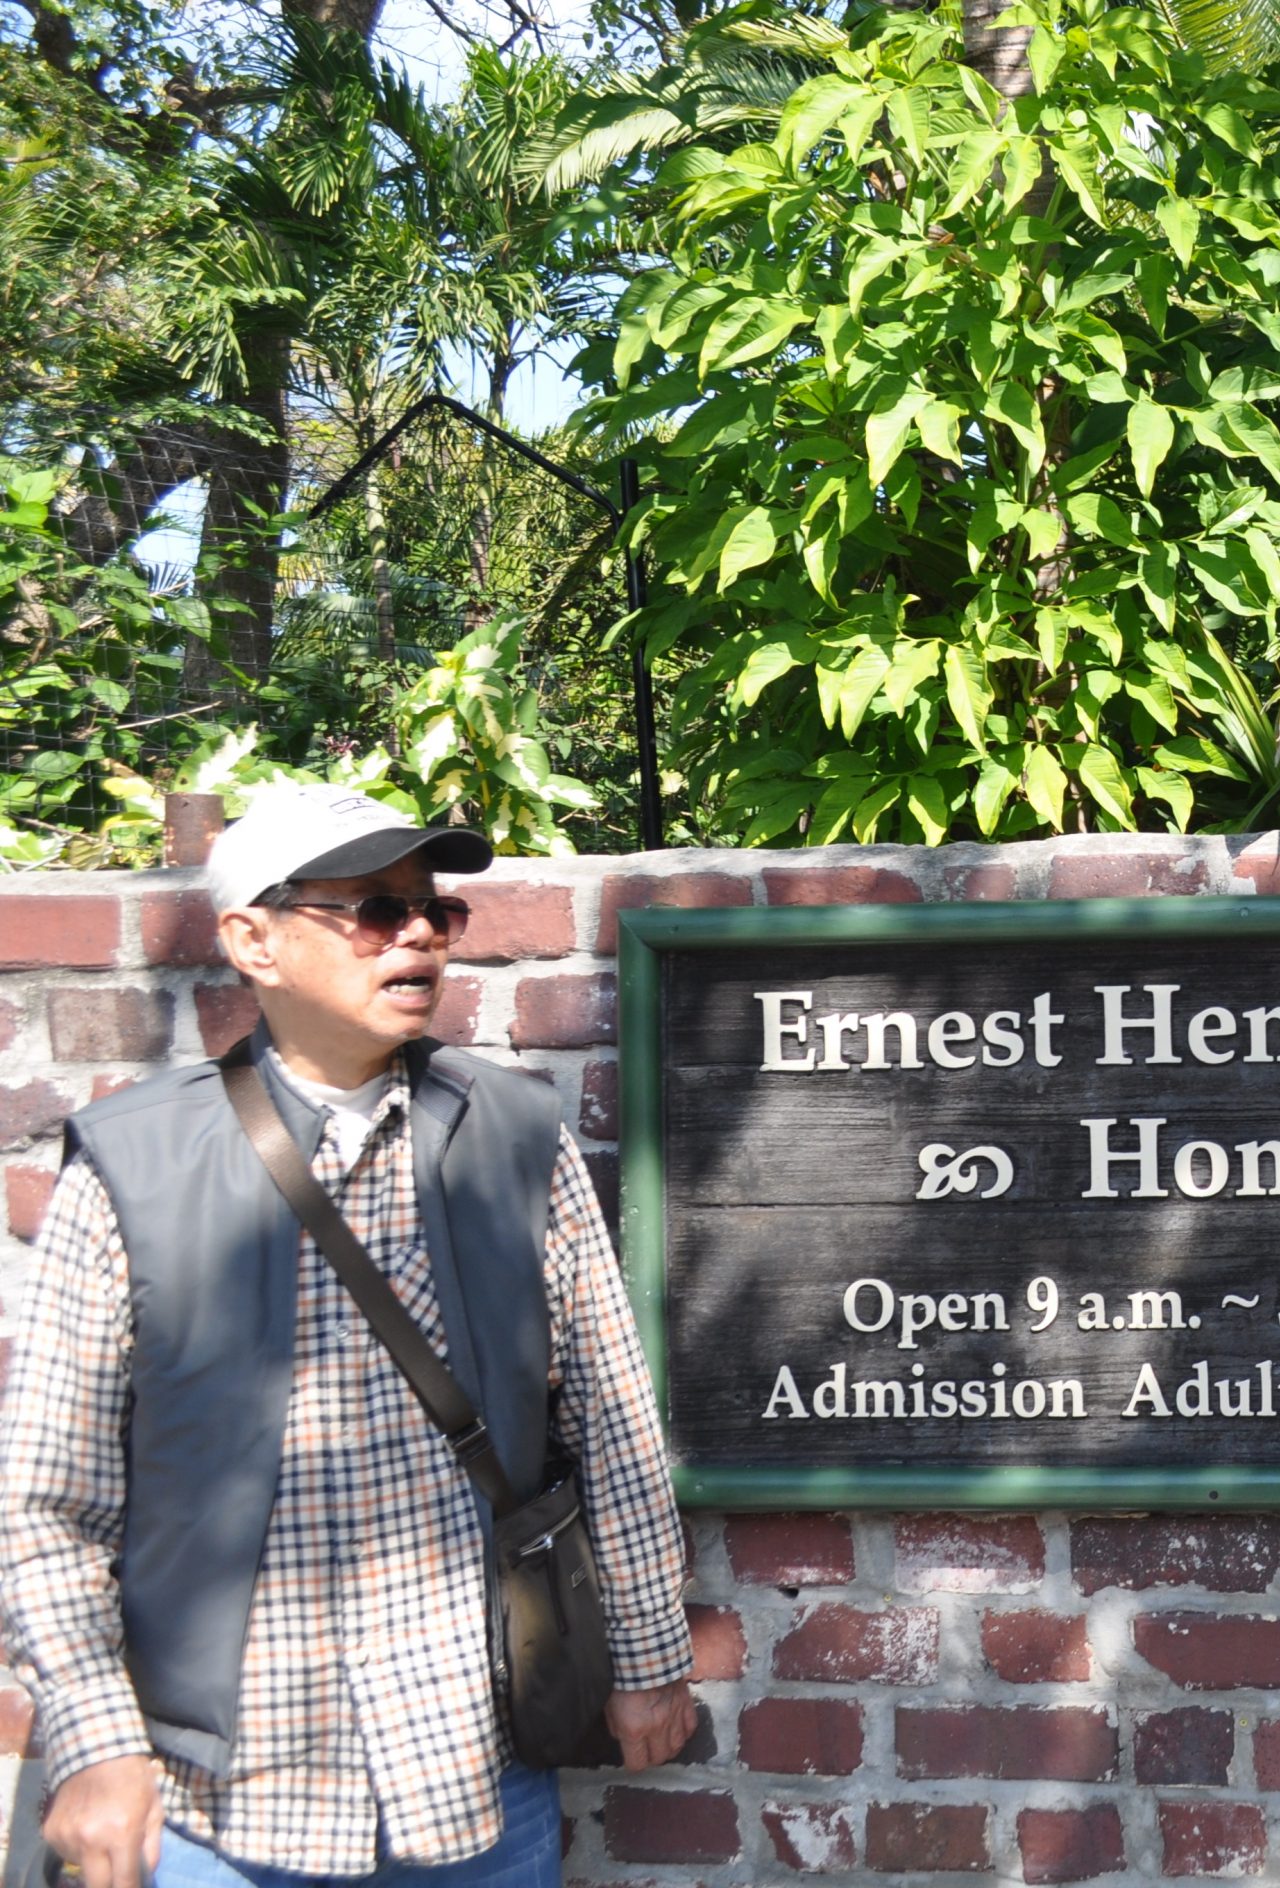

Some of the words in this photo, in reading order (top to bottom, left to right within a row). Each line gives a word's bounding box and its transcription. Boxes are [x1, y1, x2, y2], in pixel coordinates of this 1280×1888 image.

[754, 991, 1064, 1072] Ernest
[843, 1278, 1010, 1349] Open
[1026, 1275, 1059, 1333] 9
[1077, 1290, 1201, 1331] a.m.
[761, 1361, 1088, 1419] Admission
